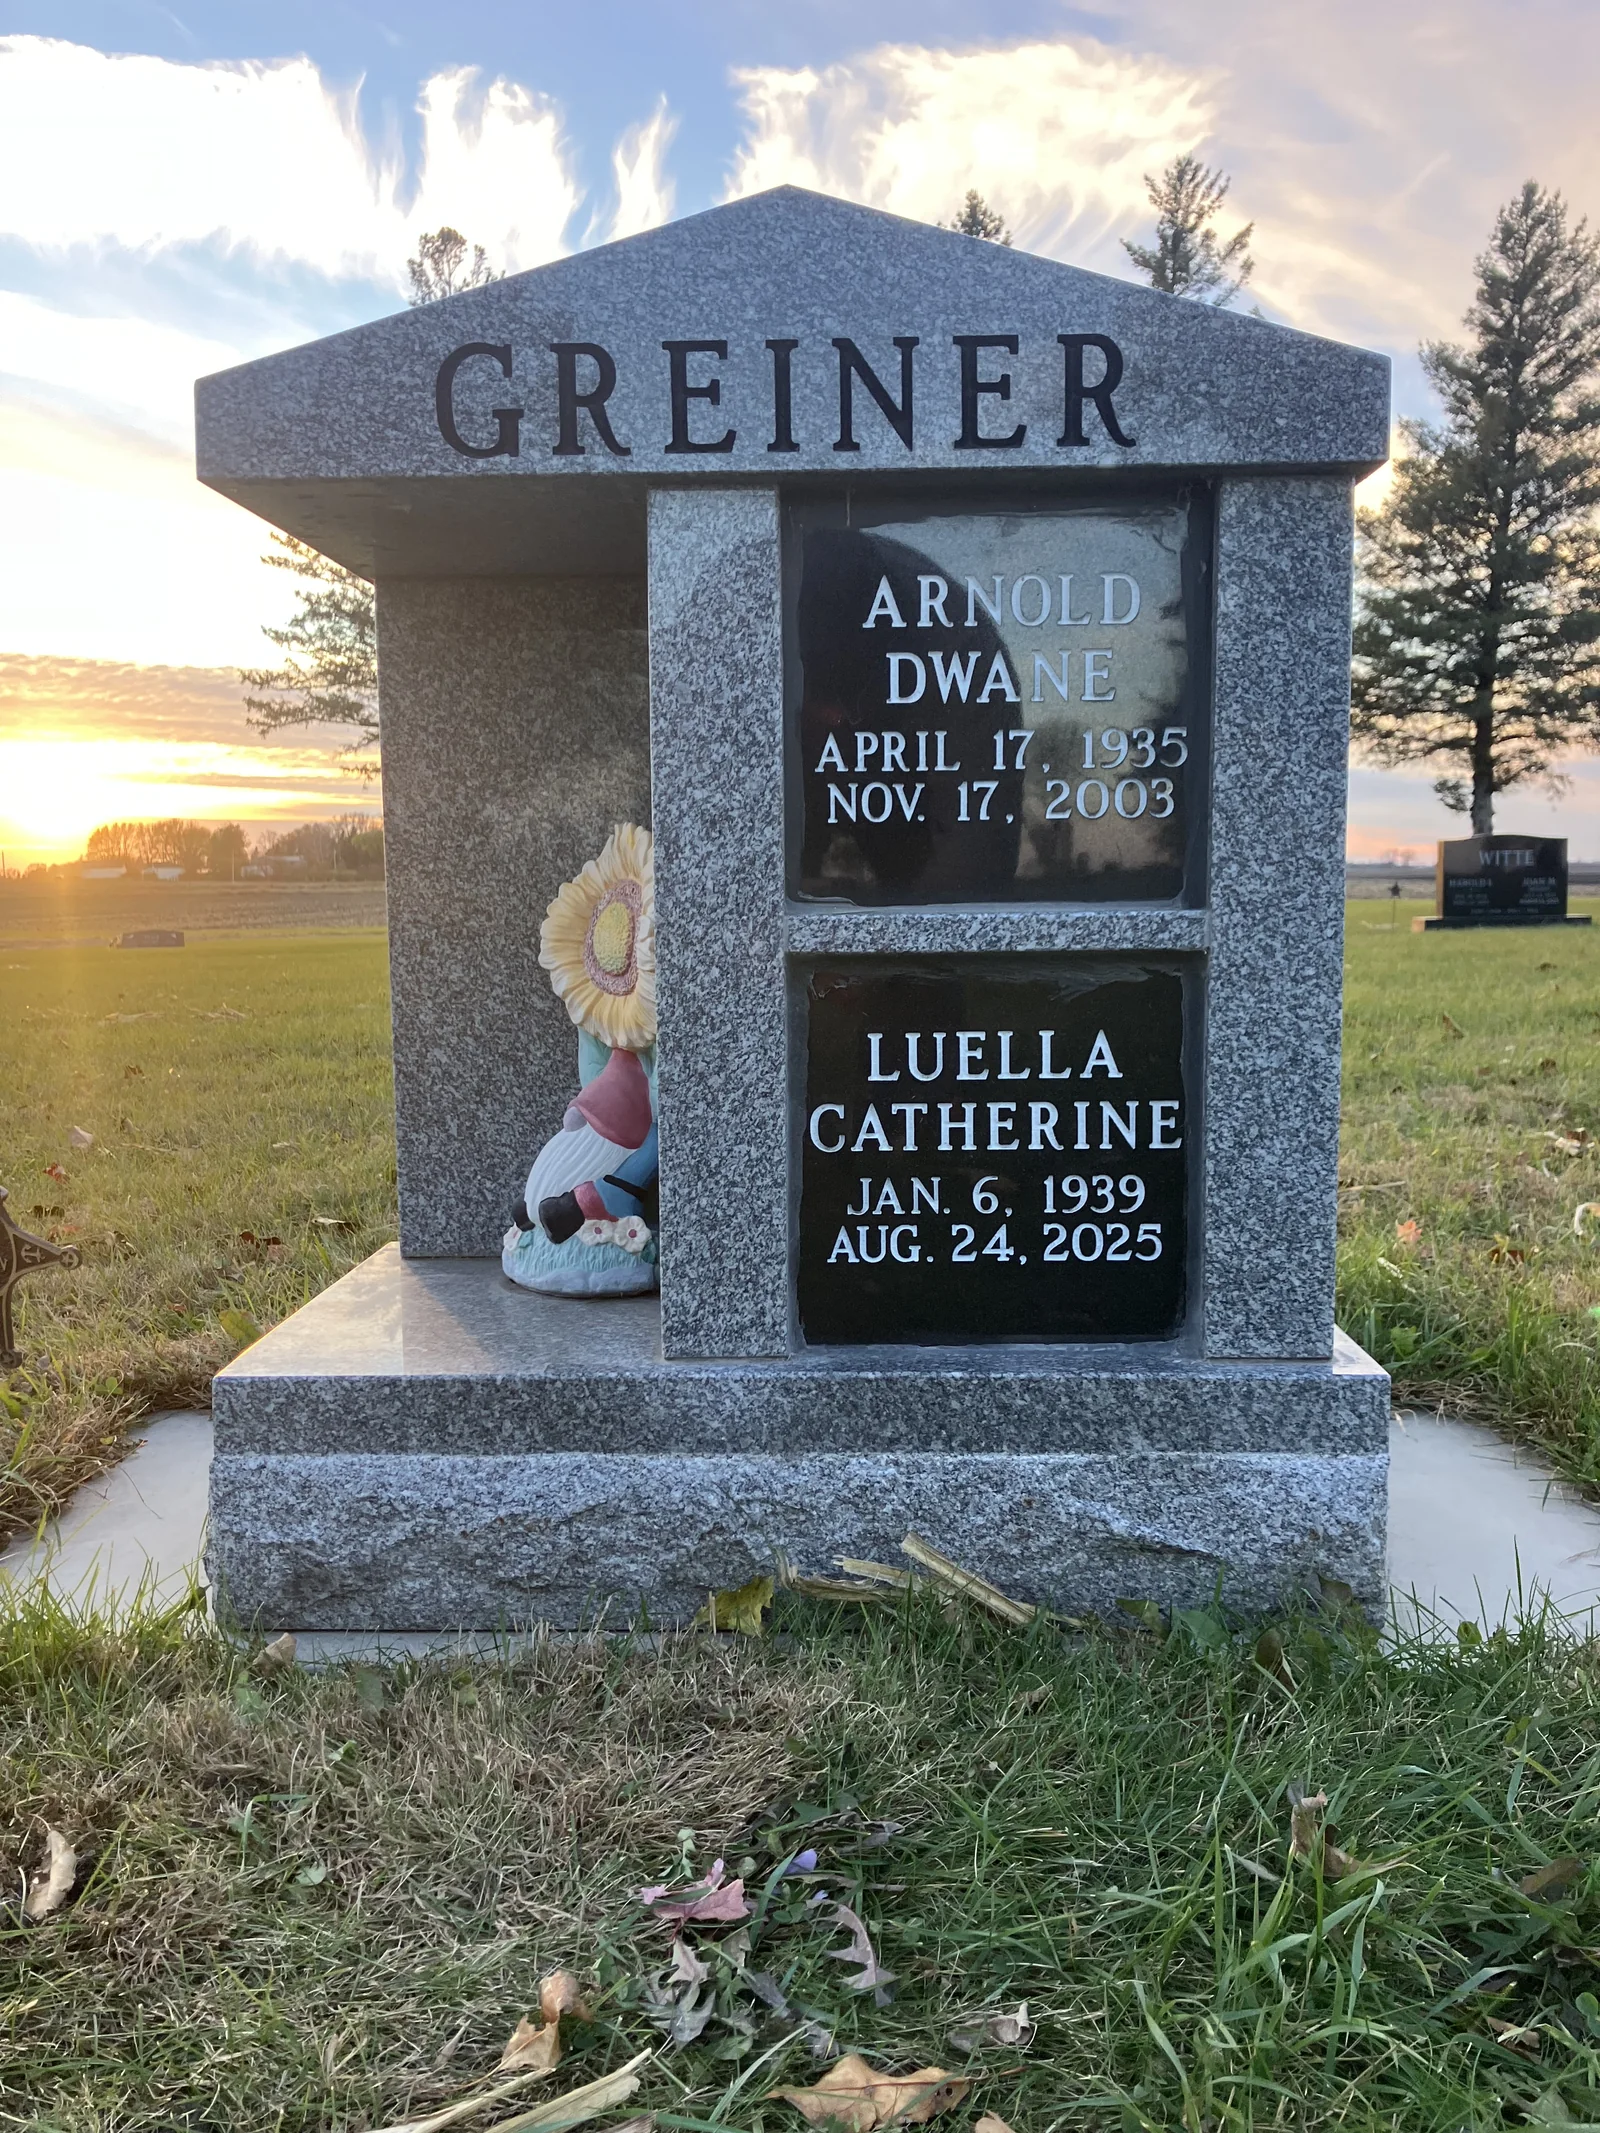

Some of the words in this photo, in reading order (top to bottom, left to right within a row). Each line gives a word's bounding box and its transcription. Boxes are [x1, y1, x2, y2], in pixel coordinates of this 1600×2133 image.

[435, 333, 1137, 459] GREINER
[862, 573, 1140, 628] ARNOLD
[886, 649, 1116, 704] DWANE
[815, 731, 960, 773] APRIL
[993, 730, 1050, 774] 17,
[1082, 727, 1188, 769] 1935
[827, 783, 925, 824] NOV.
[957, 781, 1014, 824] 17,
[1045, 778, 1174, 820] 2003
[1479, 849, 1534, 867] WITTE
[867, 1030, 1123, 1082] LUELLA
[809, 1101, 1182, 1153] CATHERINE
[847, 1177, 951, 1216] JAN.
[972, 1176, 1013, 1217] 6,
[1043, 1175, 1145, 1215] 1939
[827, 1225, 934, 1264] AUG.
[951, 1224, 1028, 1265] 24,
[1043, 1223, 1162, 1263] 2025
